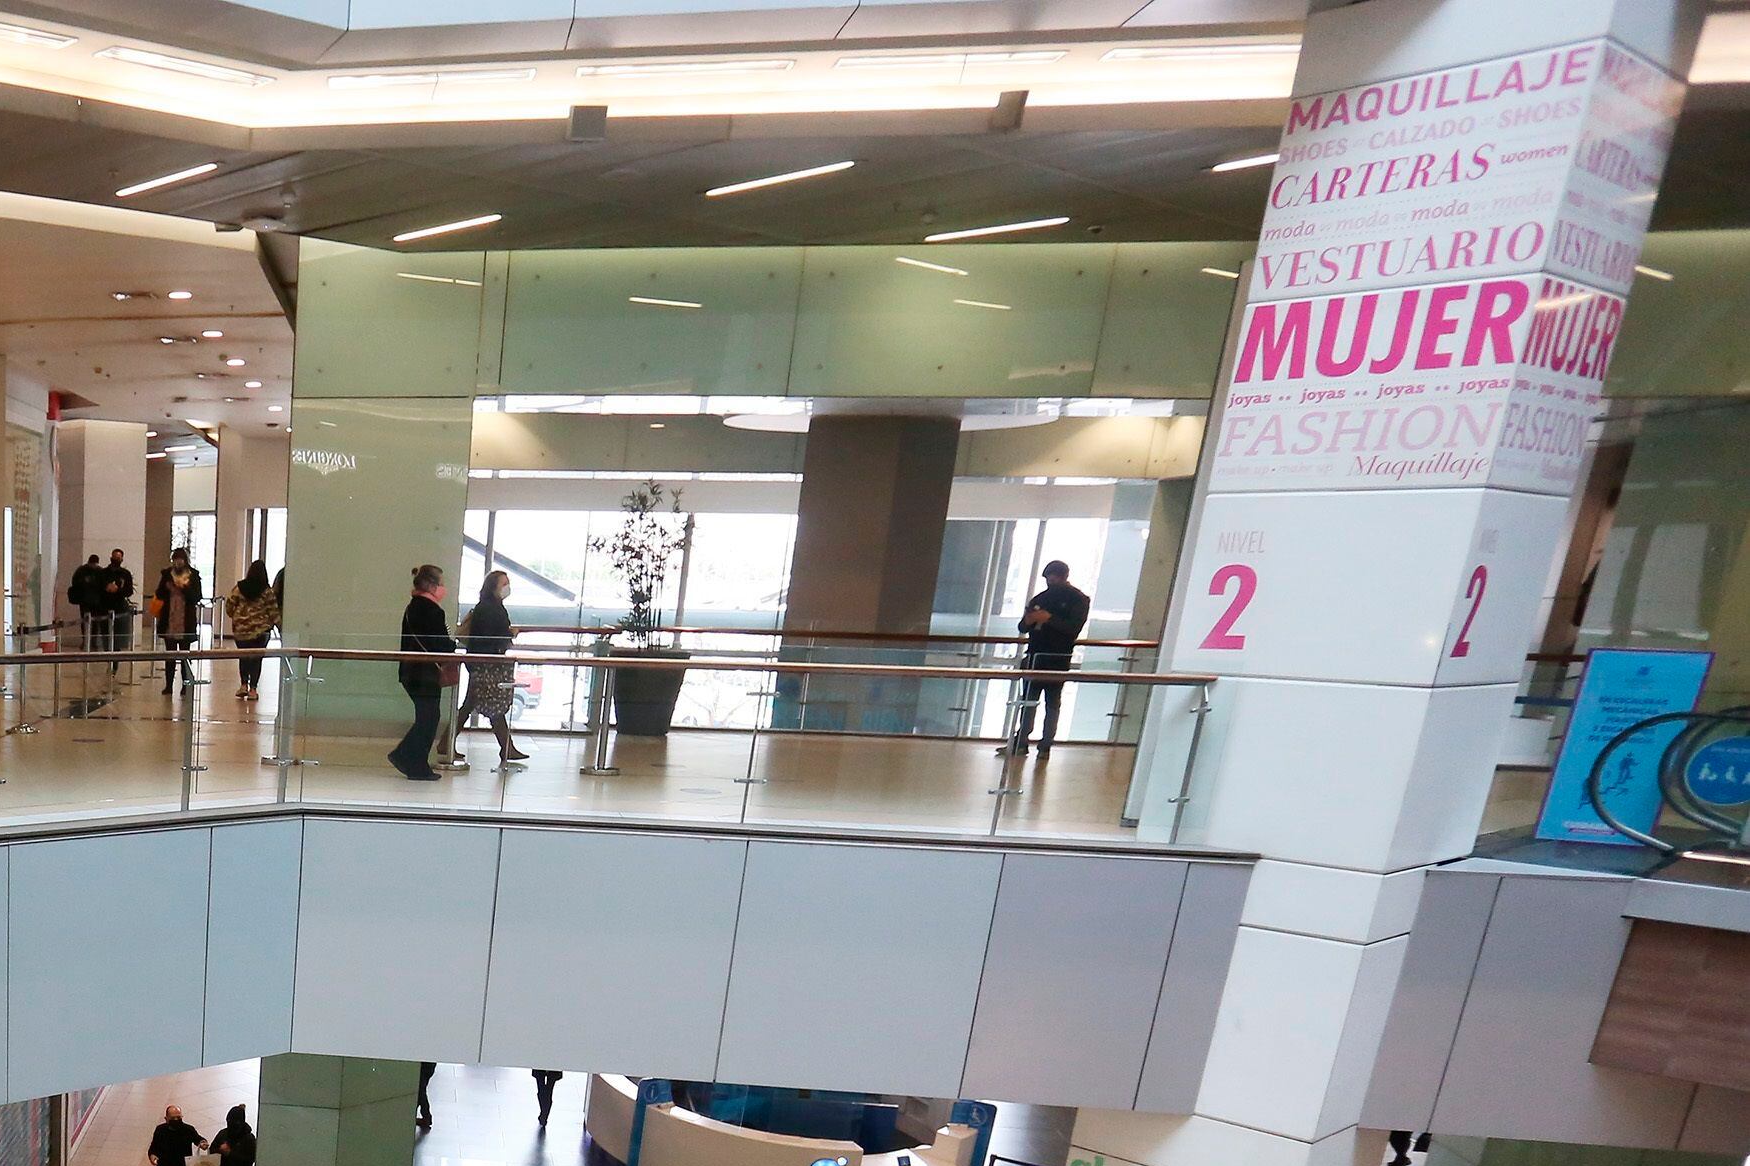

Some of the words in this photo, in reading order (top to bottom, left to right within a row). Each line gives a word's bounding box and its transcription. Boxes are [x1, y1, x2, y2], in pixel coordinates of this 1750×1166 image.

[1288, 46, 1592, 133] MAQUILLAJE
[1276, 137, 1347, 166] SHOES
[1367, 116, 1476, 151] CALZADO
[1499, 95, 1582, 129] SHOES
[1270, 150, 1489, 208] CARTERAS
[1499, 143, 1569, 165] women
[1263, 220, 1316, 241] moda
[1334, 209, 1391, 231] moda
[1410, 198, 1470, 221] moda
[1491, 187, 1554, 210] moda
[1258, 221, 1545, 289] VESTUARIO
[1236, 280, 1528, 382] MUJER
[1521, 279, 1621, 380] MUJER
[1227, 392, 1272, 409] joyas
[1299, 388, 1346, 404] joyas
[1375, 382, 1425, 399] joyas
[1457, 377, 1511, 394] joyas
[1218, 401, 1501, 457] FASHION
[1499, 401, 1591, 457] FASHION
[1351, 450, 1489, 482] Maquillaje
[1217, 531, 1266, 554] NIVEL
[1198, 564, 1258, 650] 2
[1450, 565, 1488, 658] 2
